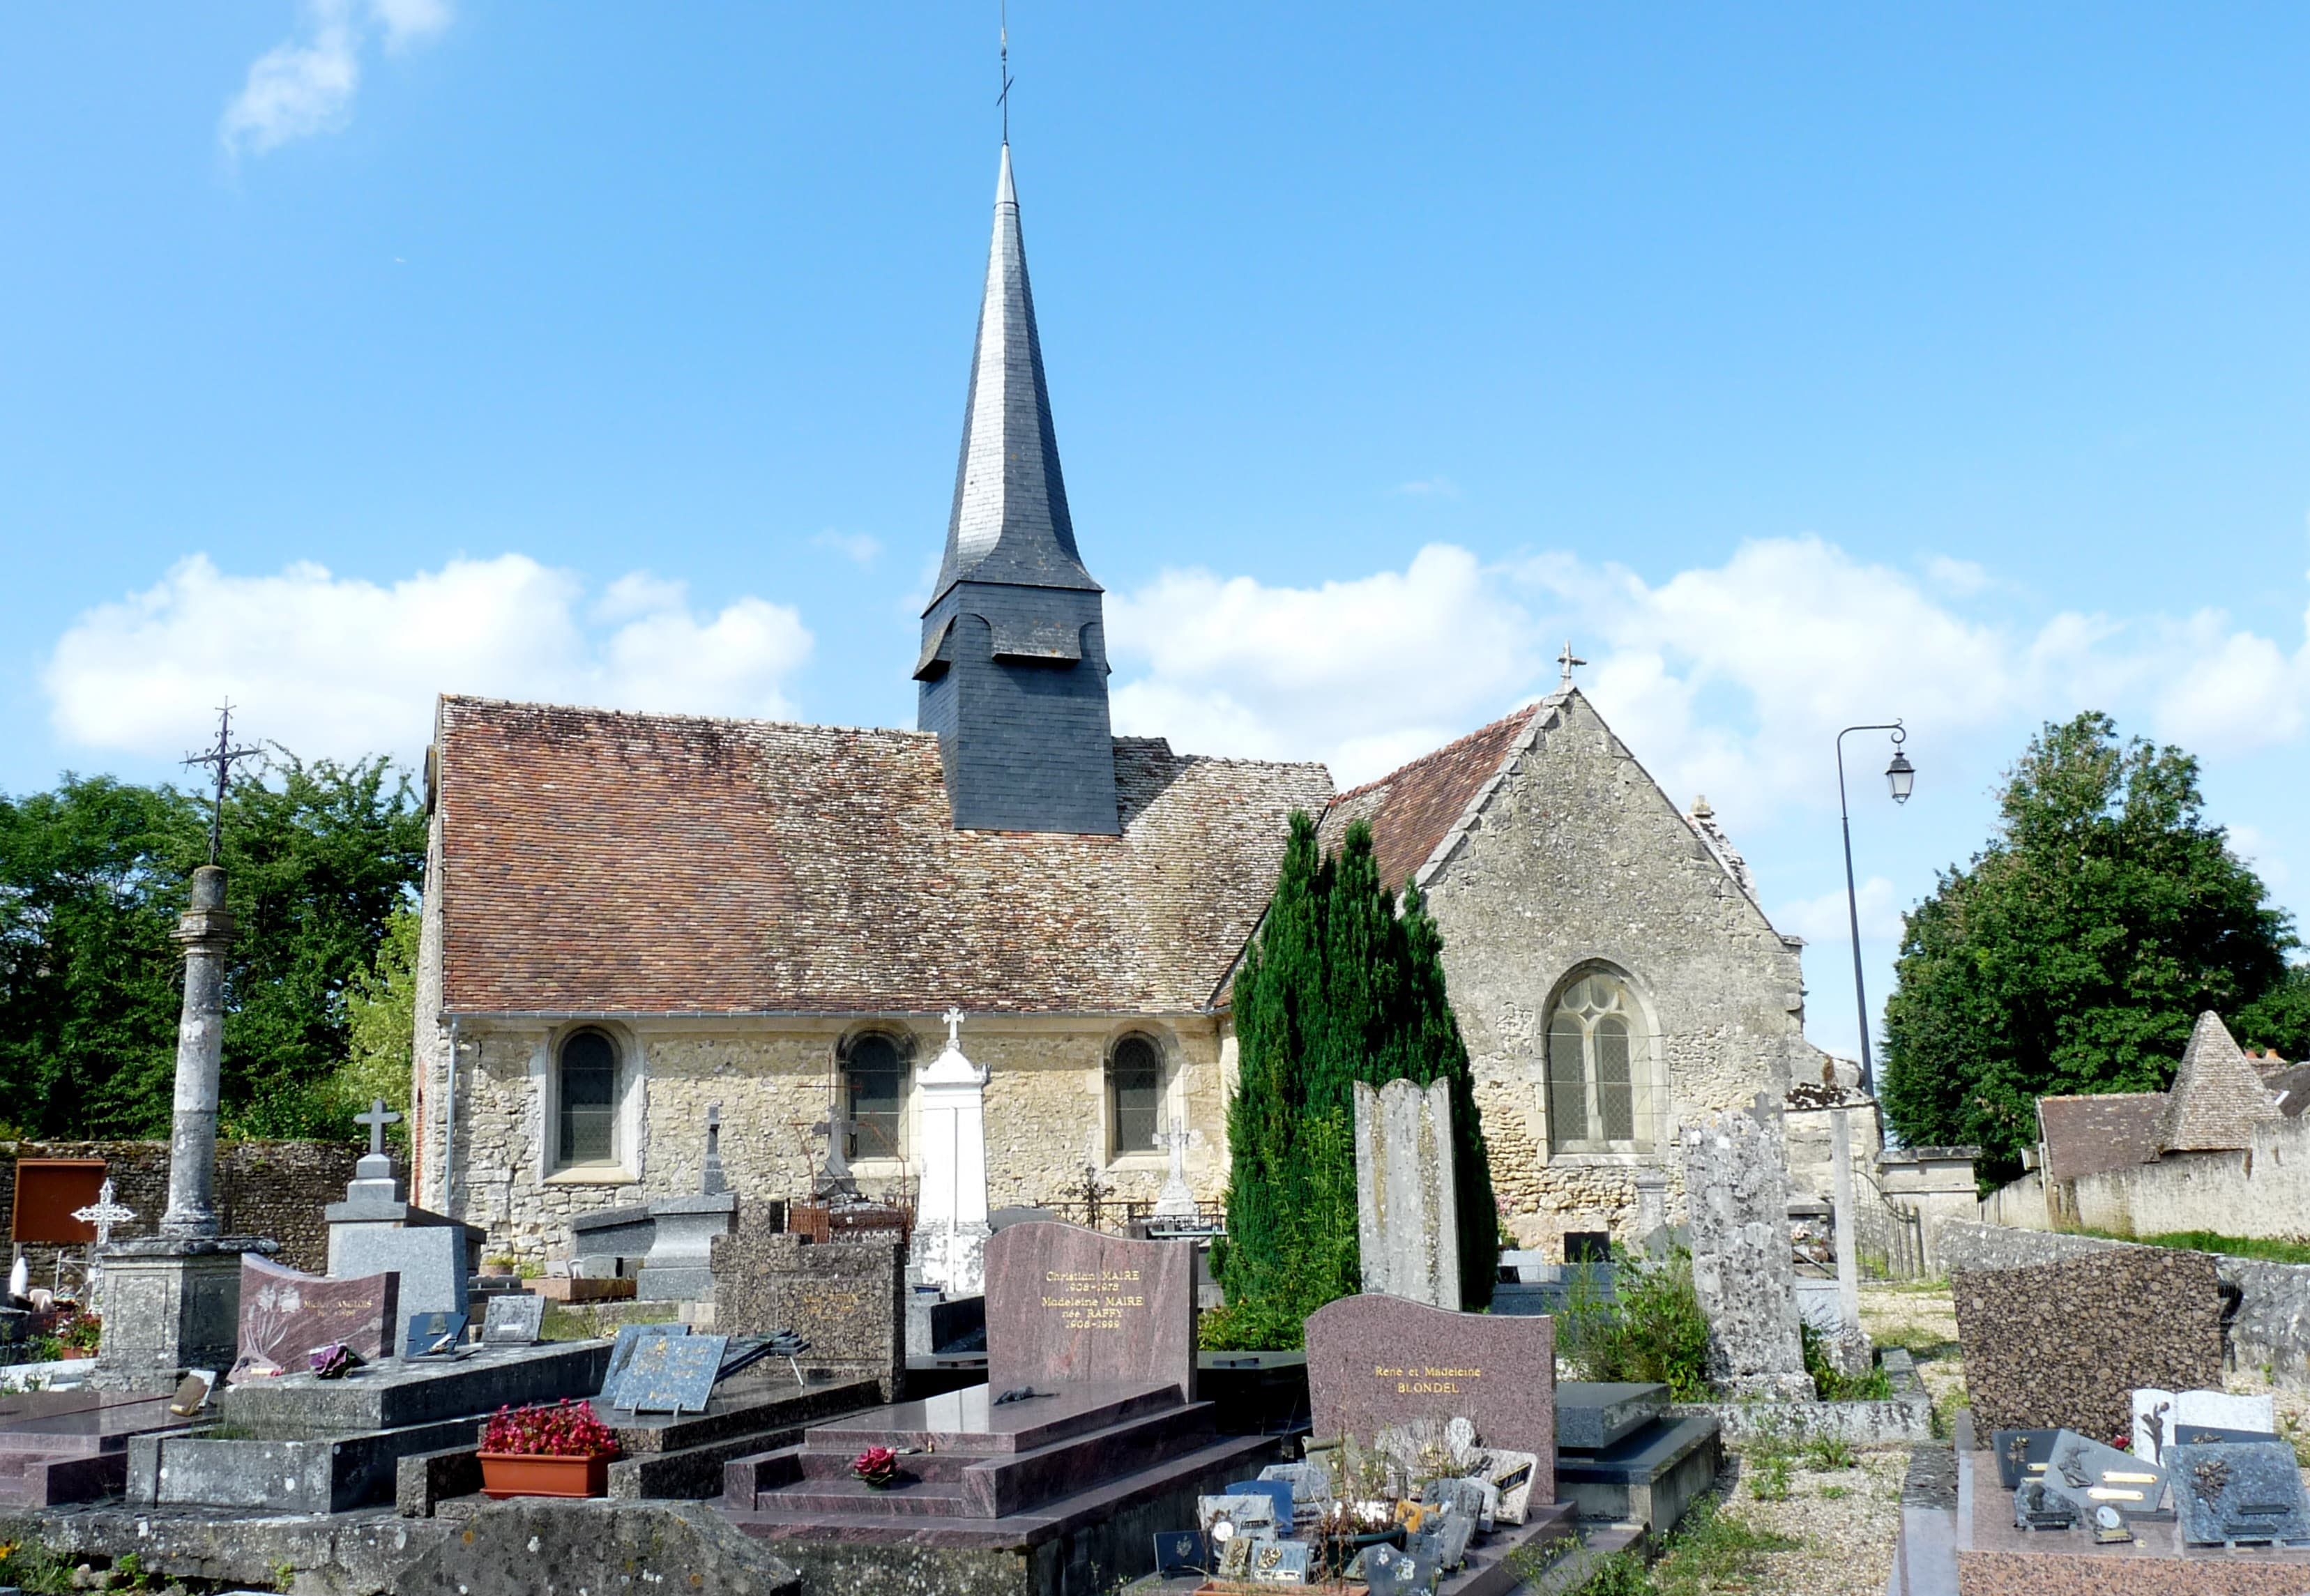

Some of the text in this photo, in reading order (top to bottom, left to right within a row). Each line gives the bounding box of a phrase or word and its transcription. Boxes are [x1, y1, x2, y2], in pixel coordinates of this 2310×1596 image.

[1046, 1270, 1140, 1282] Christian MAIRE
[1042, 1295, 1143, 1307] Madeleine MAIRE
[1062, 1309, 1081, 1318] née
[1408, 1367, 1420, 1377] et
[1424, 1365, 1482, 1377] Madeleine
[1397, 1382, 1460, 1394] BLONDEL
